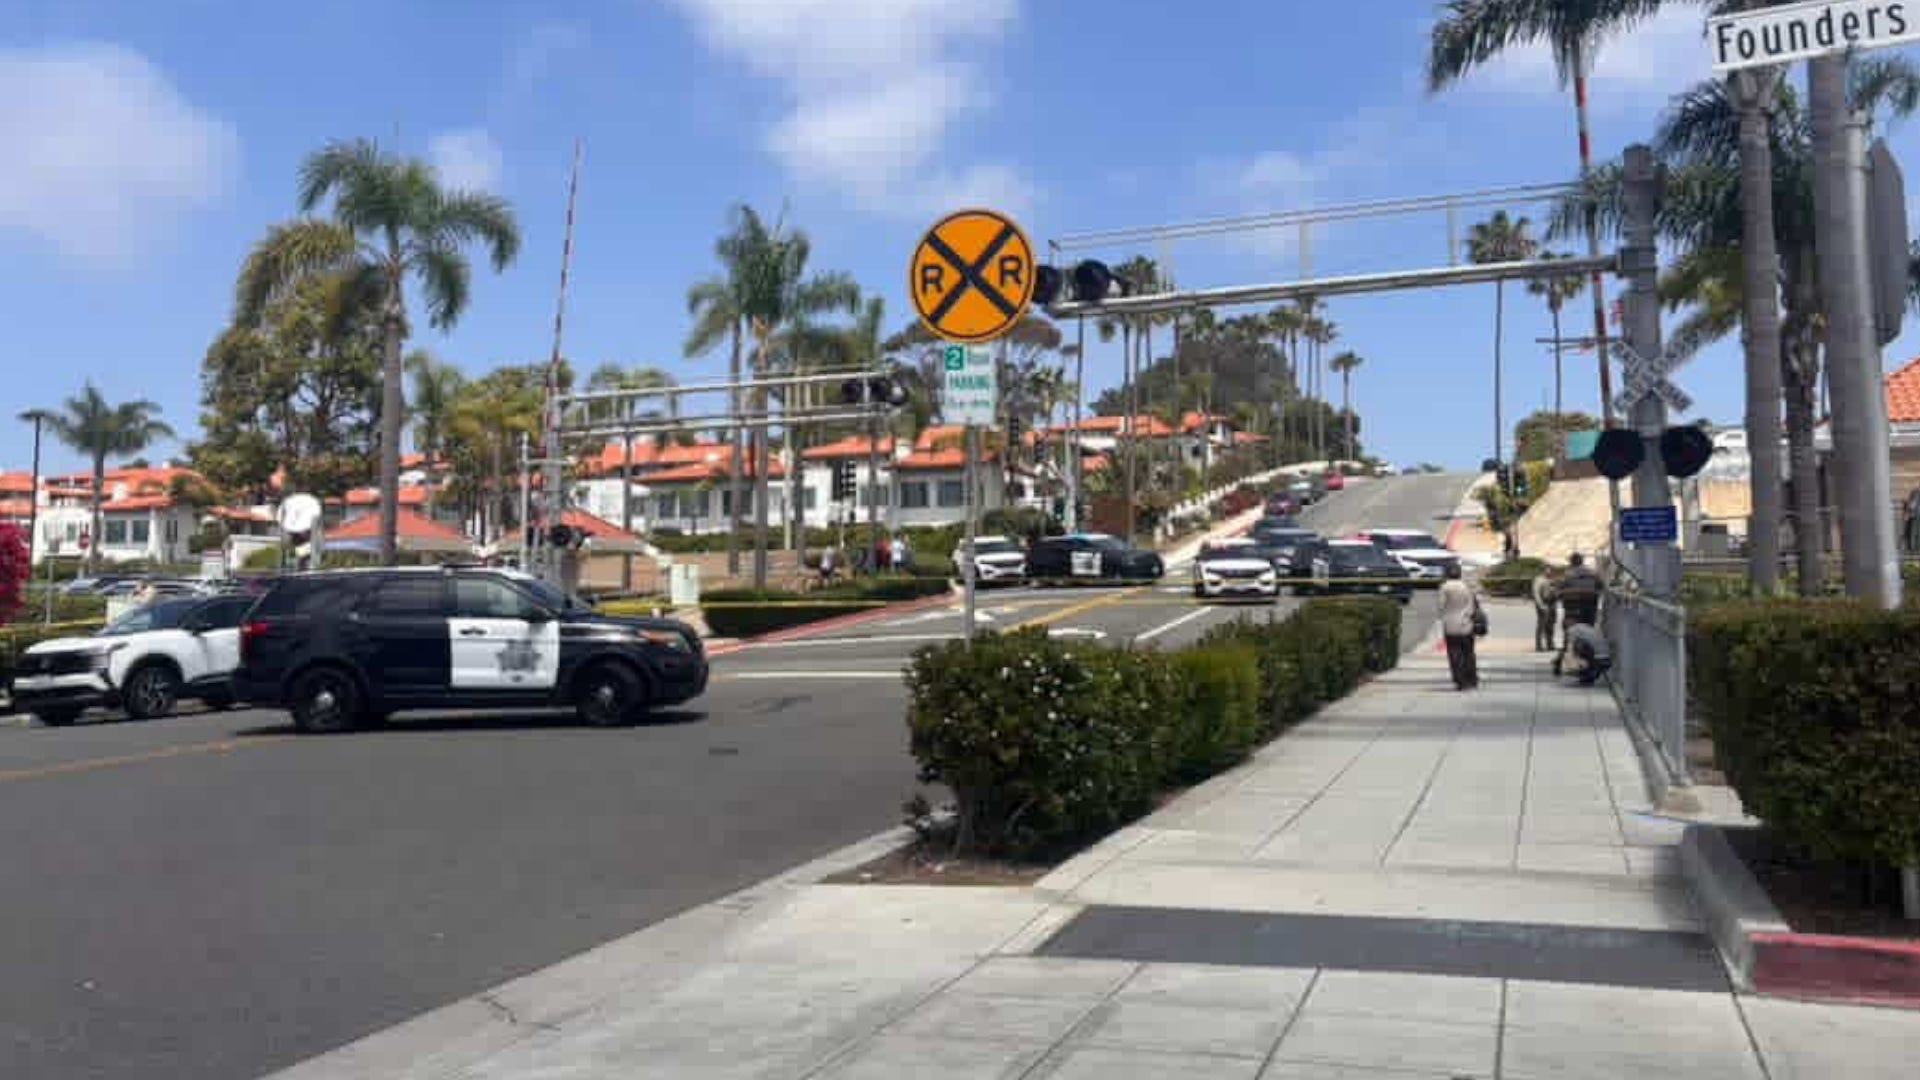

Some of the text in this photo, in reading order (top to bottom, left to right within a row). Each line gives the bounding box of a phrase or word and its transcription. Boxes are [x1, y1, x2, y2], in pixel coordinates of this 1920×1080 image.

[1716, 4, 1906, 63] Founders
[921, 256, 1022, 293] R R
[948, 349, 961, 368] 2
